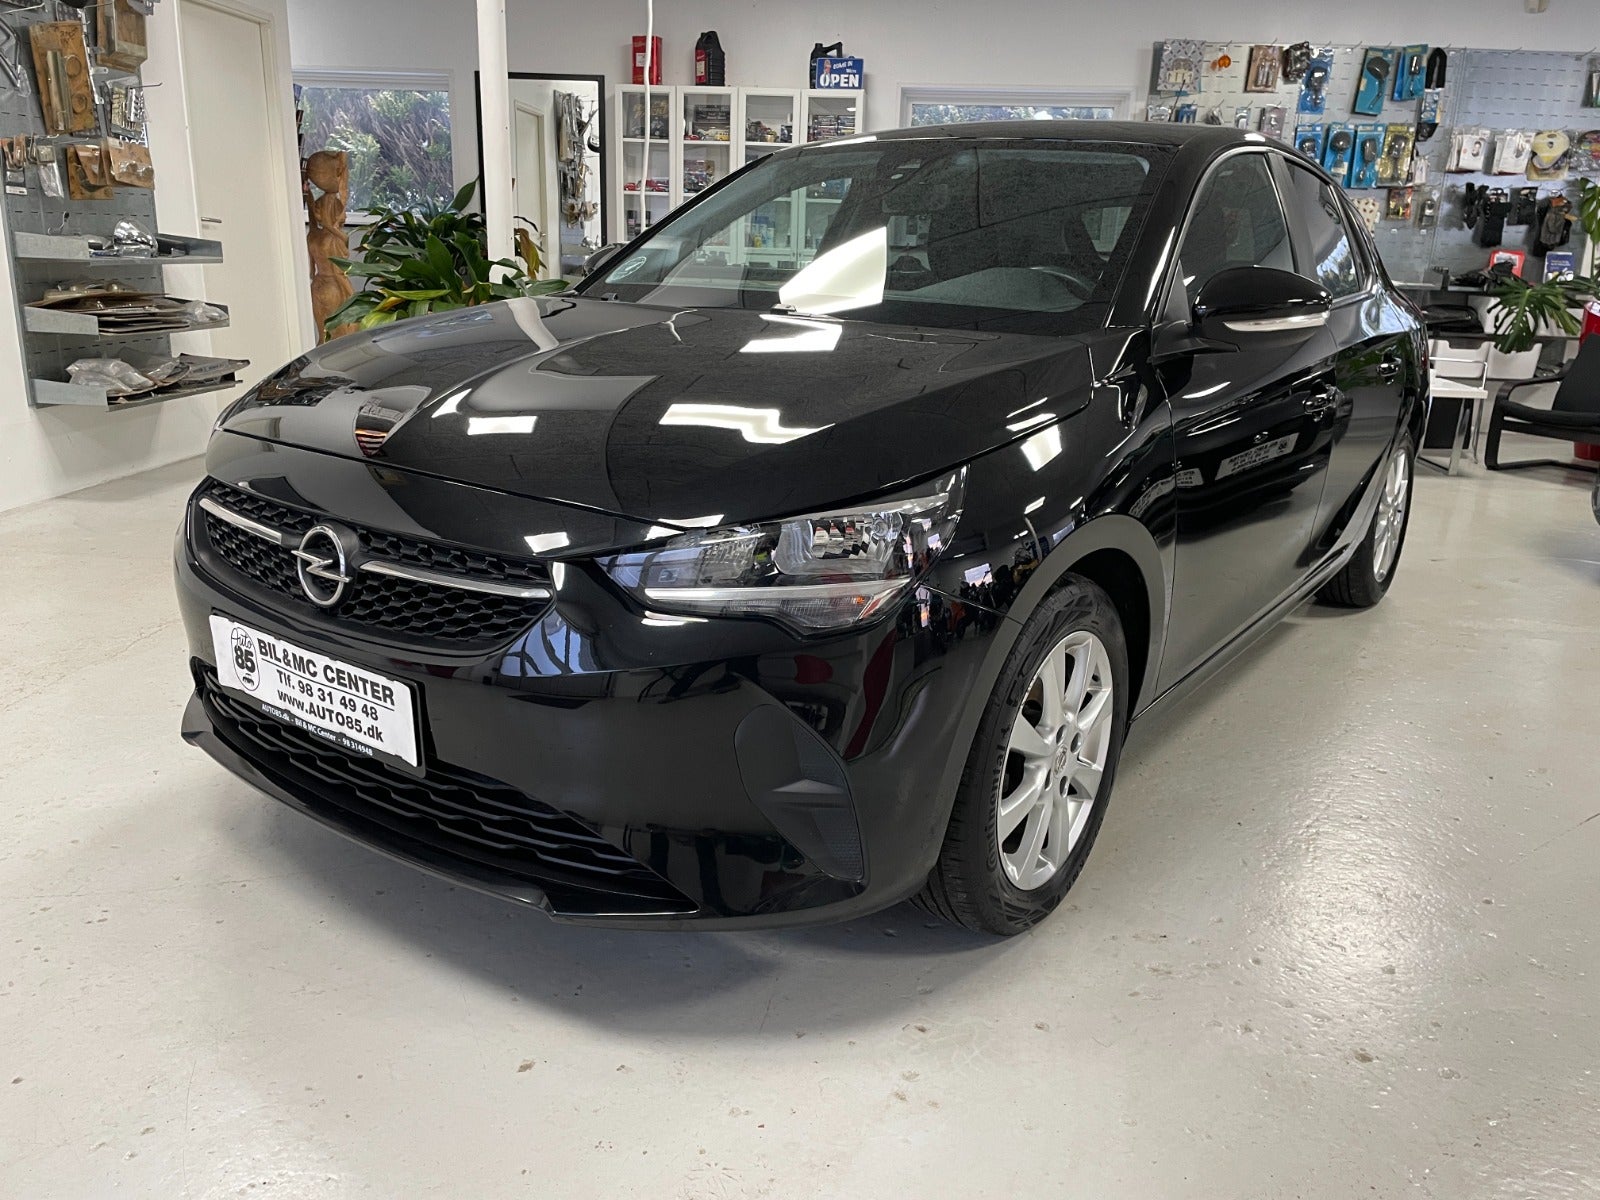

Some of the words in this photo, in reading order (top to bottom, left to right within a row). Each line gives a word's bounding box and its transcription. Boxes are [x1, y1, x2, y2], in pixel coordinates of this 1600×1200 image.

[820, 74, 860, 88] OPEN
[234, 645, 256, 674] 85
[257, 637, 318, 678] BIL&MC
[323, 664, 395, 707] CENTER
[276, 668, 296, 690] Tlf.
[298, 679, 314, 698] 98
[317, 687, 334, 706] 31
[340, 695, 357, 713] 49
[361, 703, 379, 721] 48
[277, 689, 385, 743] www.AUTO85.dk
[316, 727, 337, 742] Center
[984, 744, 1006, 873] Continental
